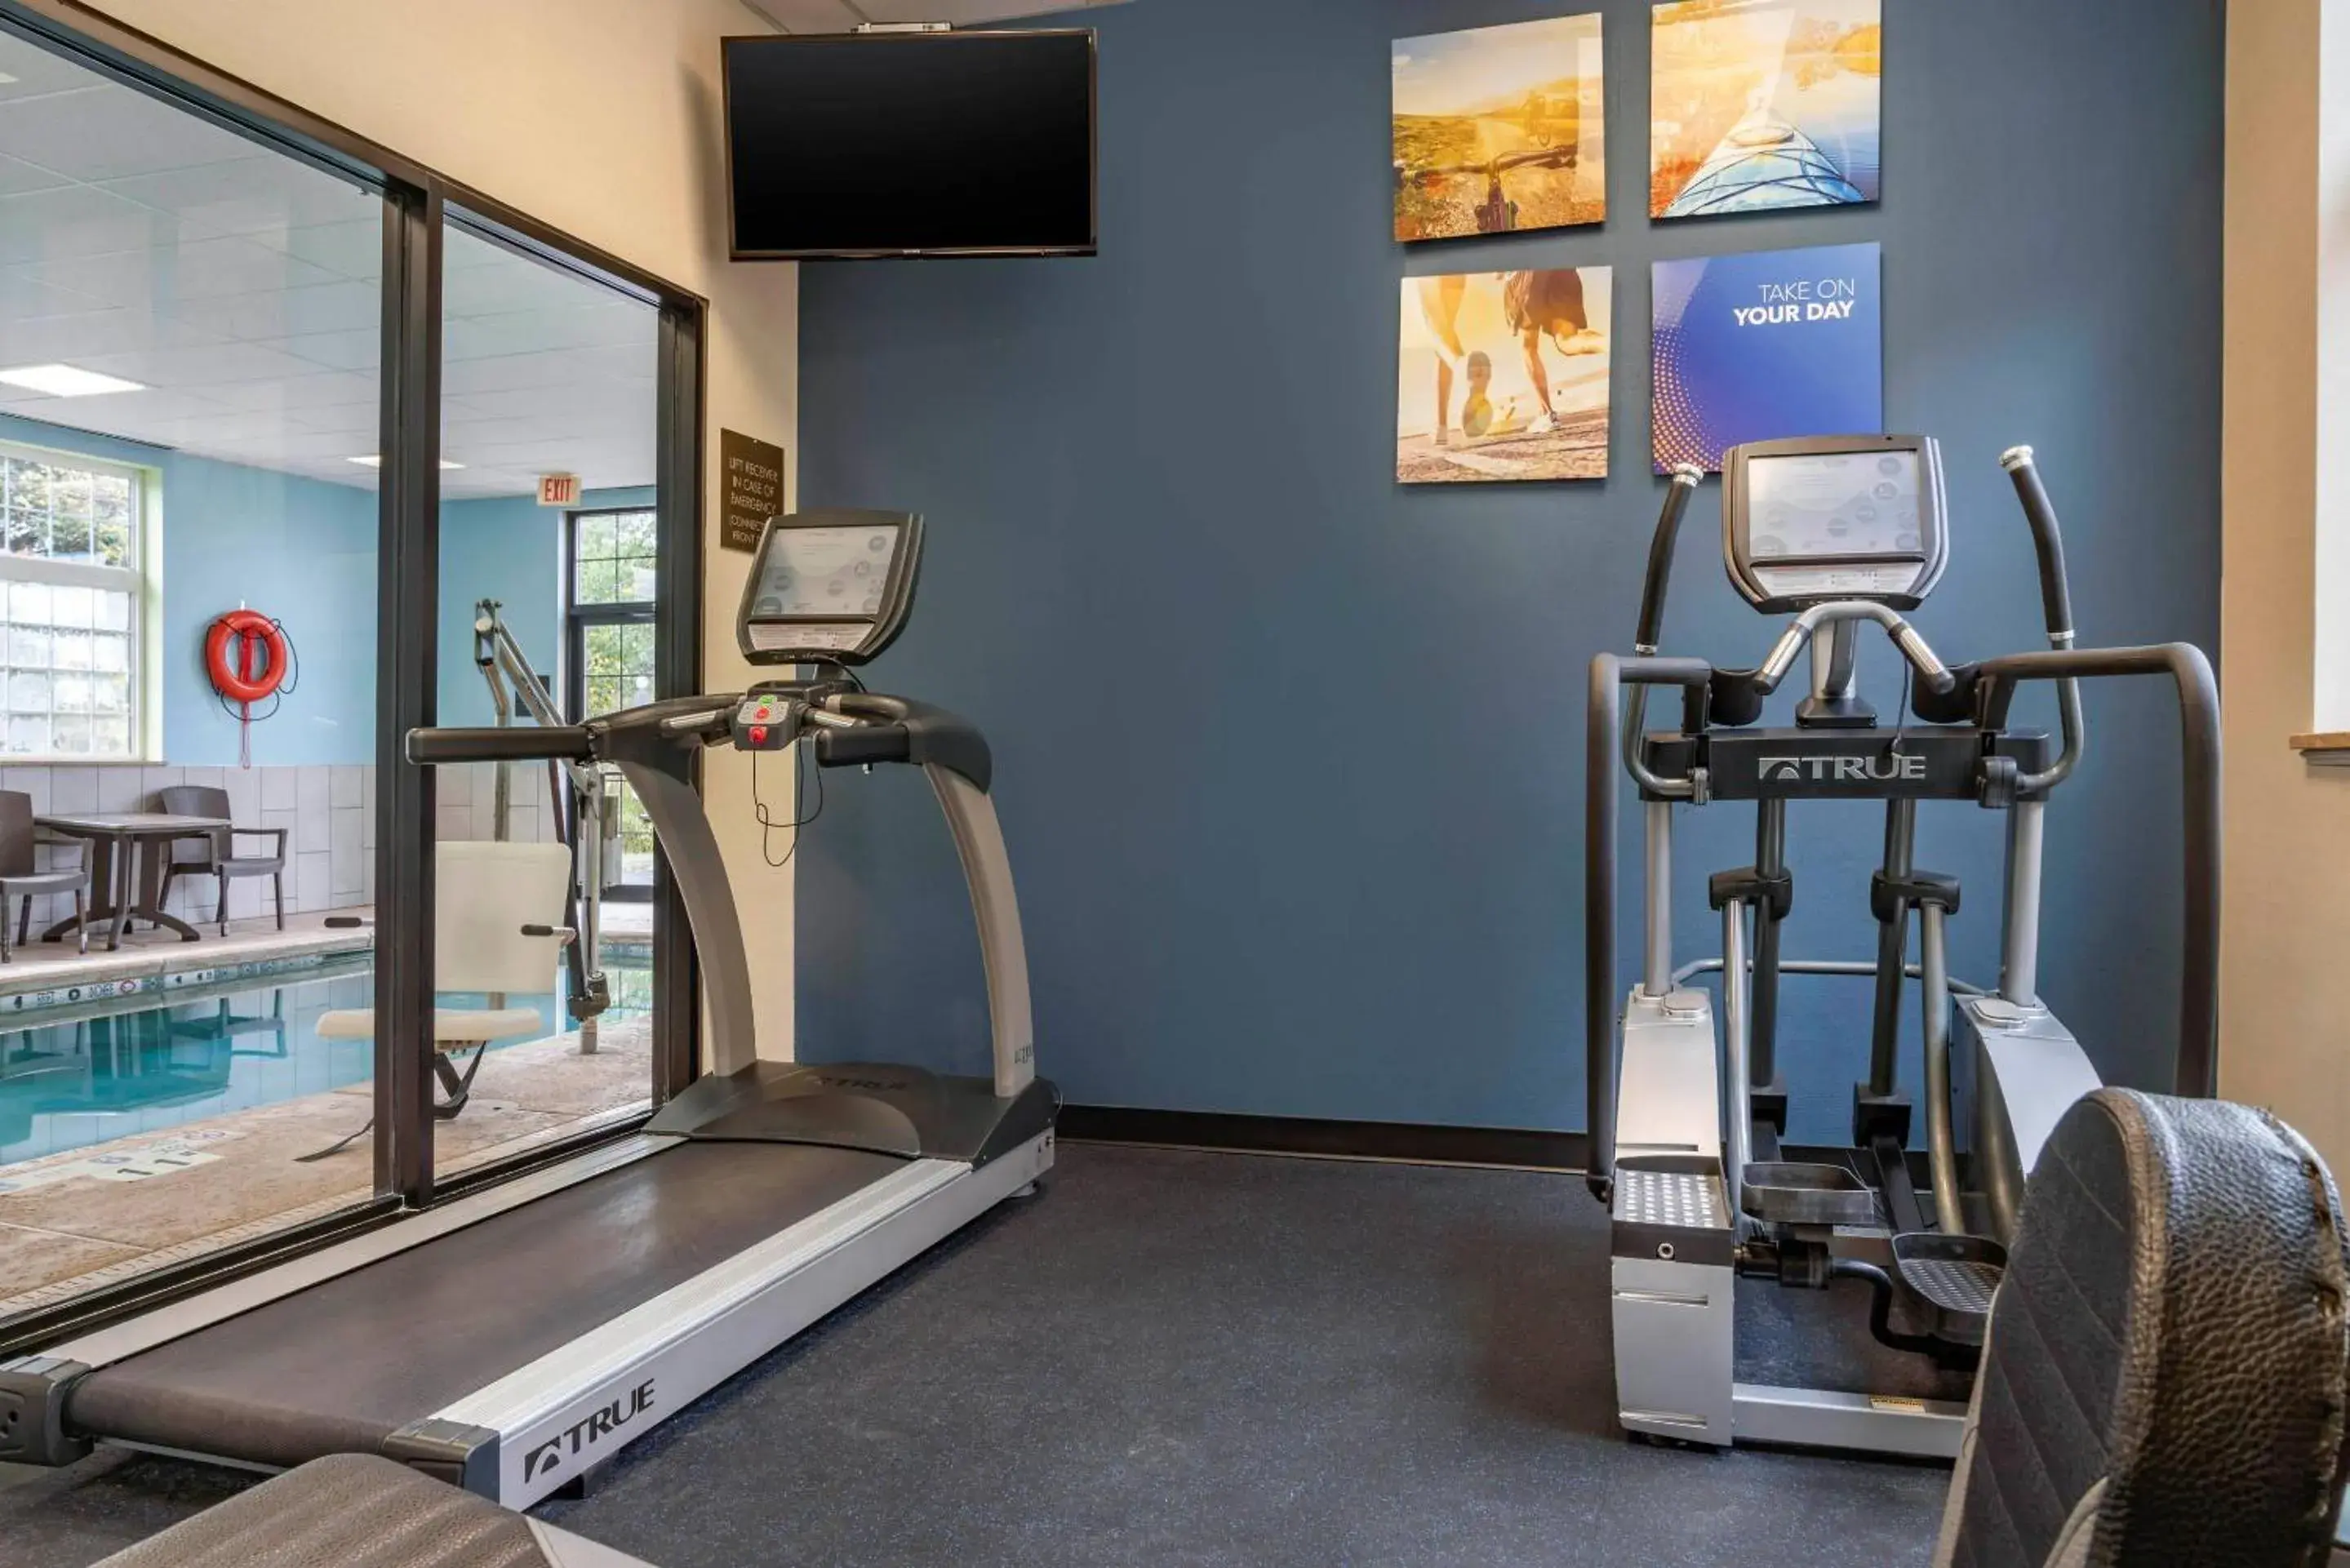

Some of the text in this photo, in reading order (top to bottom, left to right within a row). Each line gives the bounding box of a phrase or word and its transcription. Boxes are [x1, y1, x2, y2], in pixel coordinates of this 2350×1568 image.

[1758, 278, 1855, 303] TAKE ON
[1733, 300, 1855, 327] YOUR DAY
[544, 478, 572, 502] EXIT
[732, 475, 775, 498] IN CASE OF
[1801, 755, 1926, 780] TRUE
[563, 1378, 655, 1454] TRUE
